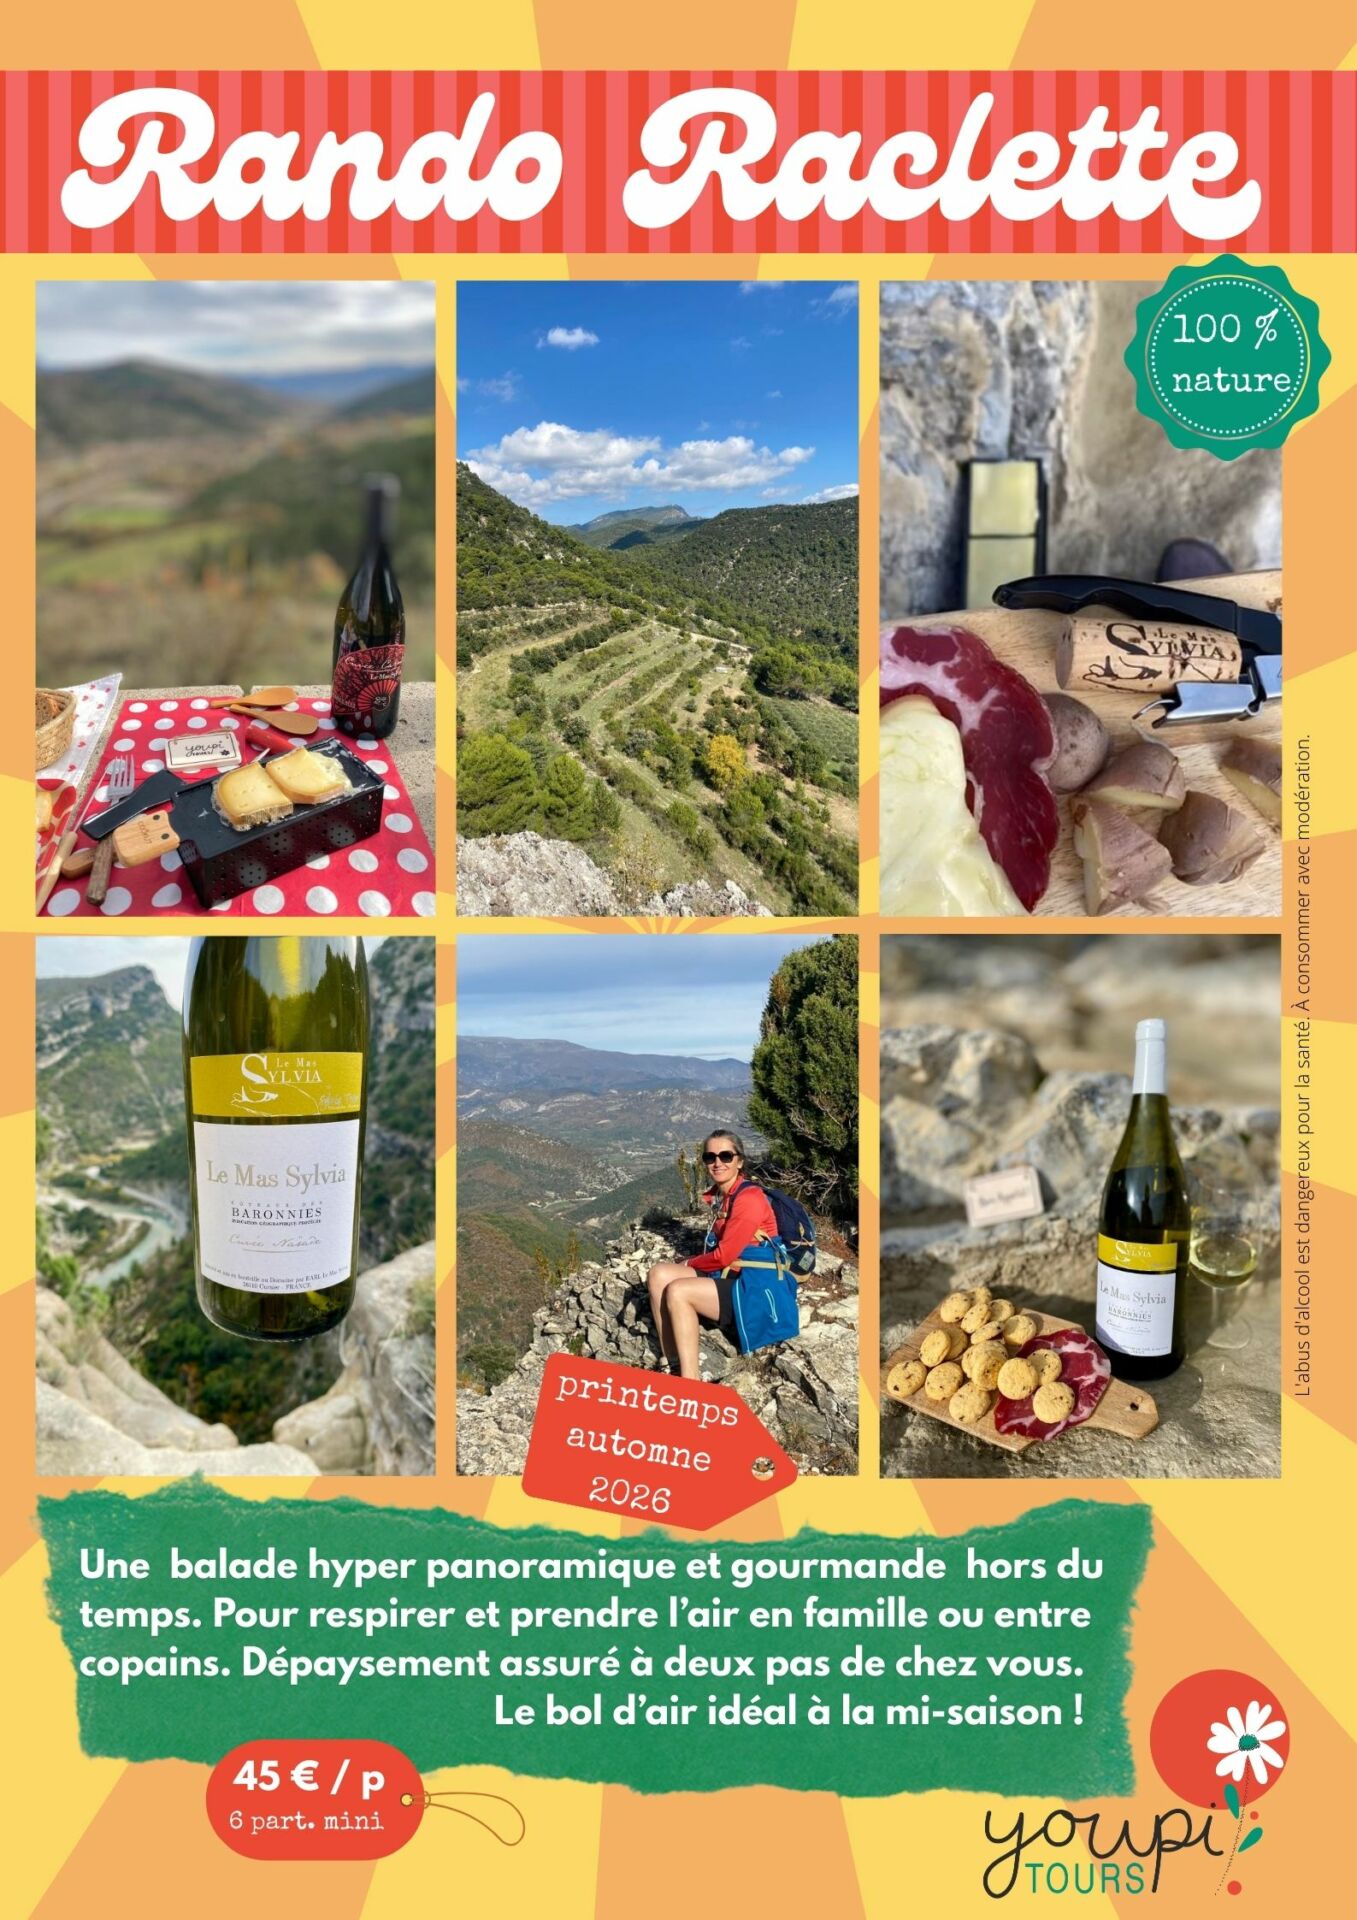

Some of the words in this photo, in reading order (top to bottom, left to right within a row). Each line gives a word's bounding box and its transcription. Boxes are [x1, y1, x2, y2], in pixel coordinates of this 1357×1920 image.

[61, 87, 563, 229] Rando
[623, 87, 1262, 240] Raclette
[1173, 313, 1241, 343] 100
[1255, 308, 1279, 349] %
[1172, 367, 1291, 392] nature
[1294, 735, 1310, 840] modération.
[1298, 846, 1310, 884] avec
[1298, 890, 1310, 994] consommer
[1291, 999, 1310, 1012] À
[276, 1057, 289, 1068] Le
[296, 1057, 318, 1068] Mas
[1294, 1017, 1310, 1068] santé.
[241, 1054, 323, 1084] SYLVIA
[1294, 1074, 1310, 1088] la
[1297, 1094, 1314, 1134] pour
[206, 1160, 229, 1184] Le
[234, 1163, 279, 1188] Mas
[286, 1162, 346, 1195] Sylvia
[1294, 1141, 1314, 1233] dangereux
[231, 1206, 322, 1220] BARONNIES
[1297, 1239, 1310, 1264] est
[1294, 1270, 1310, 1335] d'alcool
[1294, 1341, 1310, 1396] L'abus
[555, 1375, 739, 1429] printemps
[566, 1427, 711, 1472] automne
[589, 1476, 671, 1514] 2026
[80, 1548, 150, 1579] Une
[171, 1547, 298, 1579] balade
[309, 1547, 417, 1588] hyper
[427, 1548, 676, 1588] panoramique
[686, 1552, 722, 1579] et
[731, 1547, 947, 1589] gourmande
[967, 1547, 1047, 1579] hors
[1057, 1547, 1103, 1579] du
[80, 1601, 202, 1637] temps.
[214, 1597, 299, 1628] Pour
[309, 1597, 455, 1637] respirer
[465, 1601, 500, 1628] et
[511, 1596, 658, 1637] prendre
[669, 1596, 740, 1628] l’air
[749, 1607, 793, 1628] en
[803, 1595, 928, 1628] famille
[938, 1607, 984, 1628] ou
[994, 1601, 1091, 1628] entre
[79, 1646, 231, 1686] copains.
[243, 1645, 490, 1686] Dépaysement
[500, 1646, 620, 1677] assuré
[630, 1646, 653, 1677] à
[664, 1645, 755, 1677] deux
[766, 1656, 830, 1686] pas
[840, 1645, 886, 1677] de
[895, 1645, 977, 1677] chez
[987, 1656, 1084, 1677] vous.
[495, 1695, 535, 1725] Le
[546, 1694, 602, 1725] bol
[613, 1694, 698, 1725] d’air
[708, 1694, 796, 1725] idéal
[807, 1695, 830, 1725] à
[842, 1694, 874, 1725] la
[886, 1694, 1062, 1725] mi-saison
[1073, 1693, 1084, 1725] !
[233, 1760, 280, 1791] 45
[290, 1759, 320, 1792] €
[362, 1771, 386, 1800] p
[229, 1810, 243, 1830] 6
[251, 1811, 315, 1835] part.
[323, 1811, 384, 1831] mini
[983, 1801, 1225, 1899] youpi
[1025, 1862, 1146, 1894] TOURS
